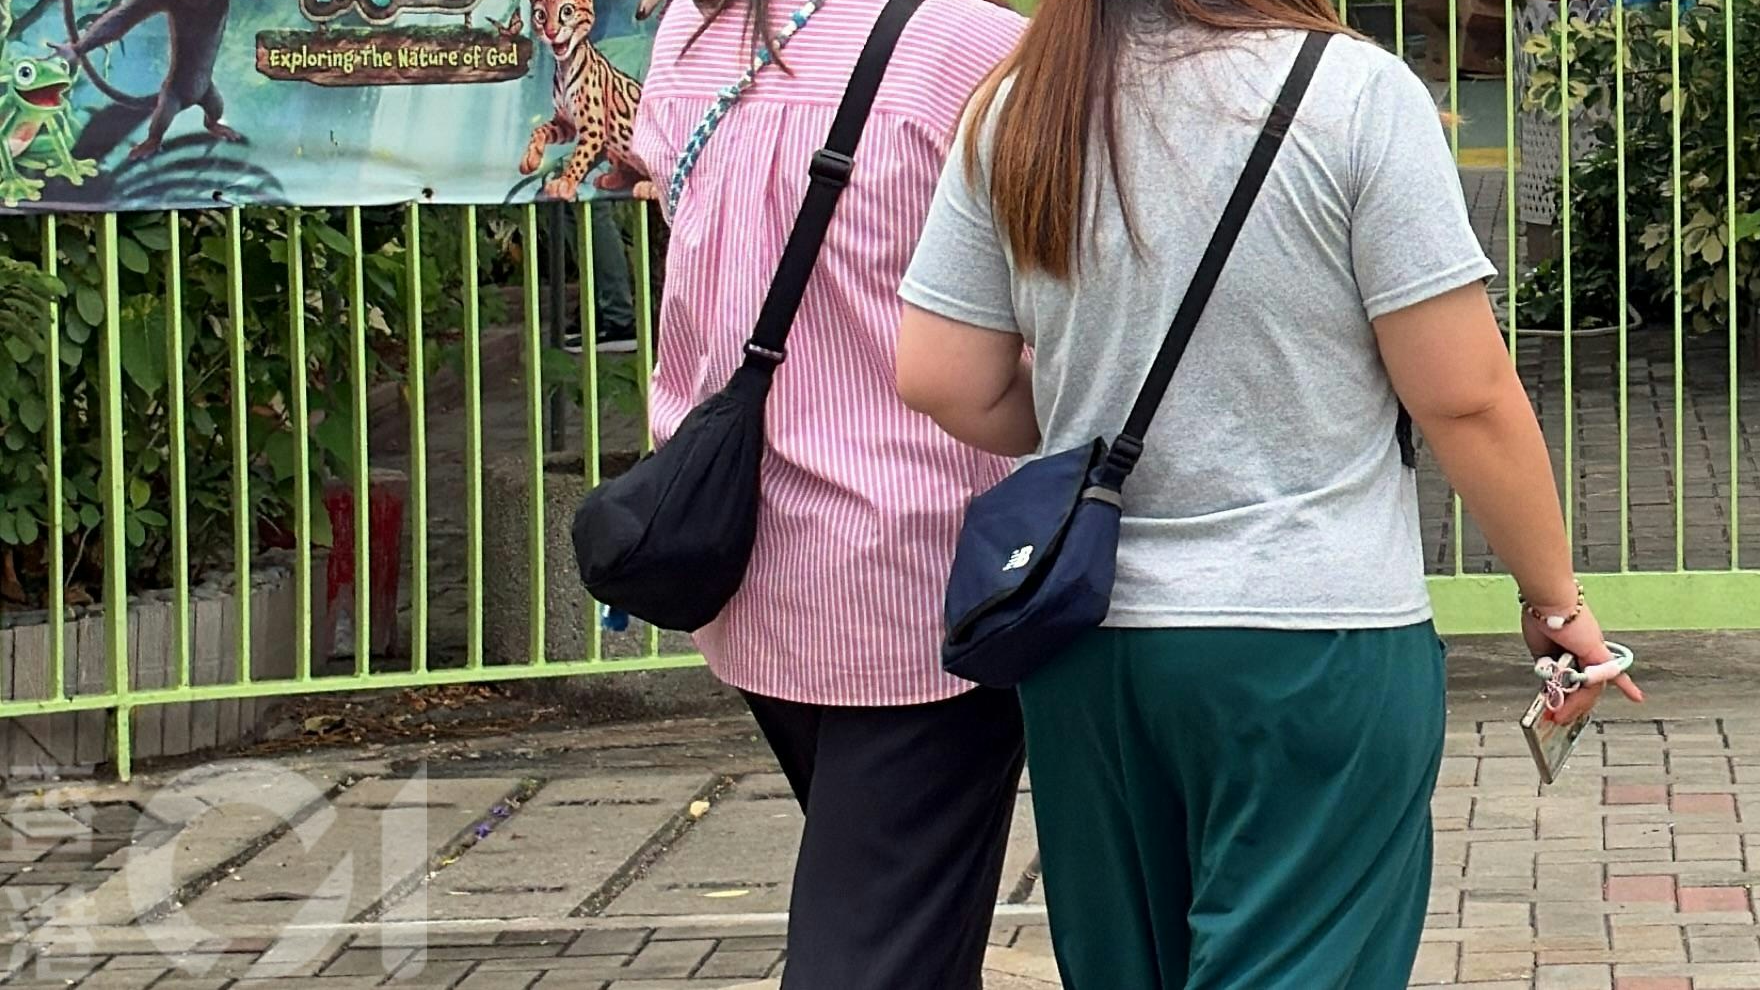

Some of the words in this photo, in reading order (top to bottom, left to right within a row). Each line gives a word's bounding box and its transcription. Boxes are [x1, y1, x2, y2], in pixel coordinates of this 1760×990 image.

[270, 45, 354, 73] Exploring
[360, 44, 392, 67] The
[399, 46, 458, 68] Nature
[463, 46, 481, 67] of
[486, 44, 518, 67] God
